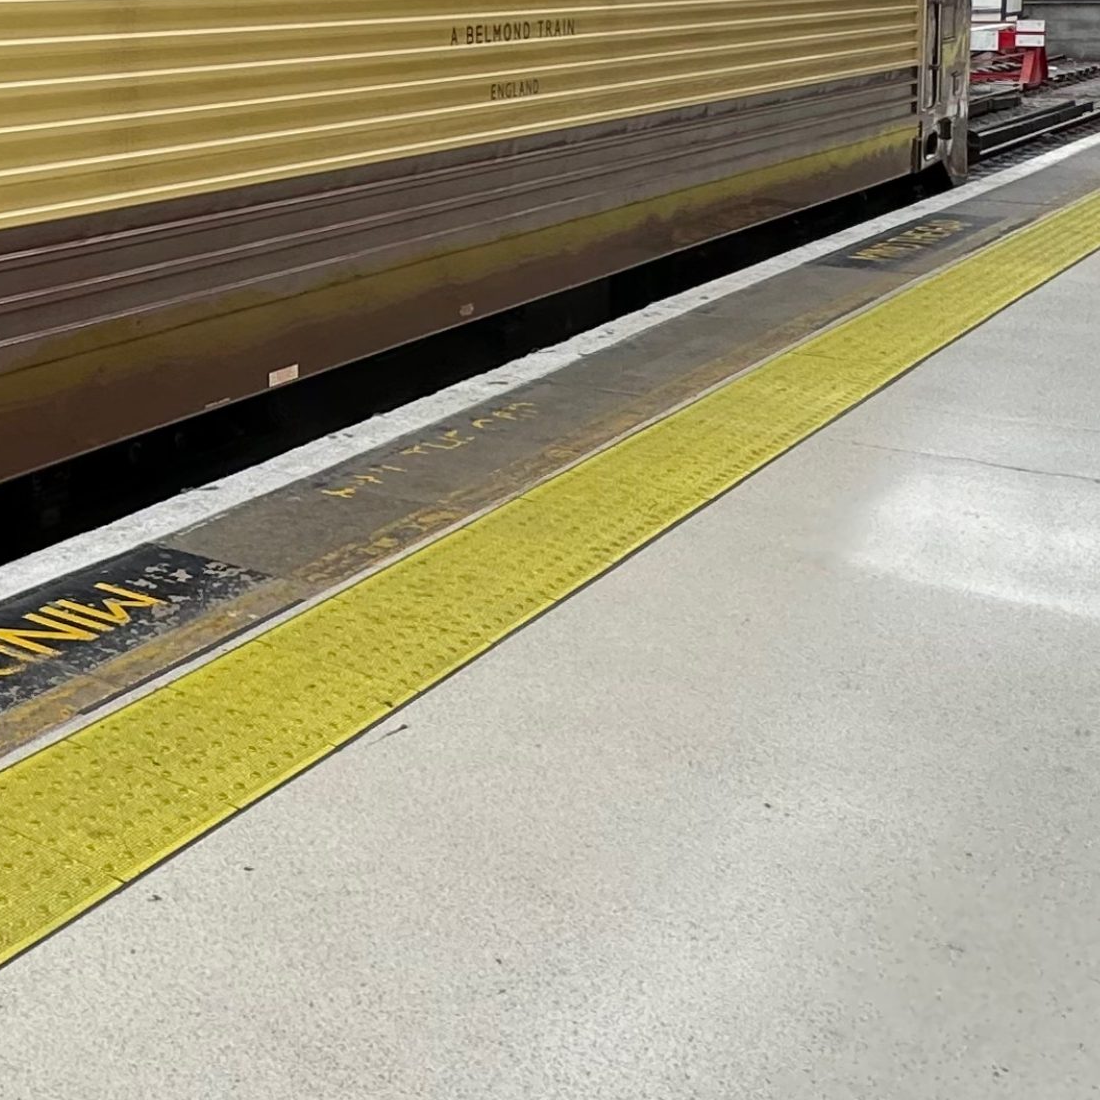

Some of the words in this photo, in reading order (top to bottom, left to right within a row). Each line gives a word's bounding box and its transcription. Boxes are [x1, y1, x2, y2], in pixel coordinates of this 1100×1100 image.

[450, 26, 459, 46] A
[465, 20, 532, 45] BELMOND
[537, 18, 576, 39] TRAIN
[490, 78, 540, 101] ENGLAND
